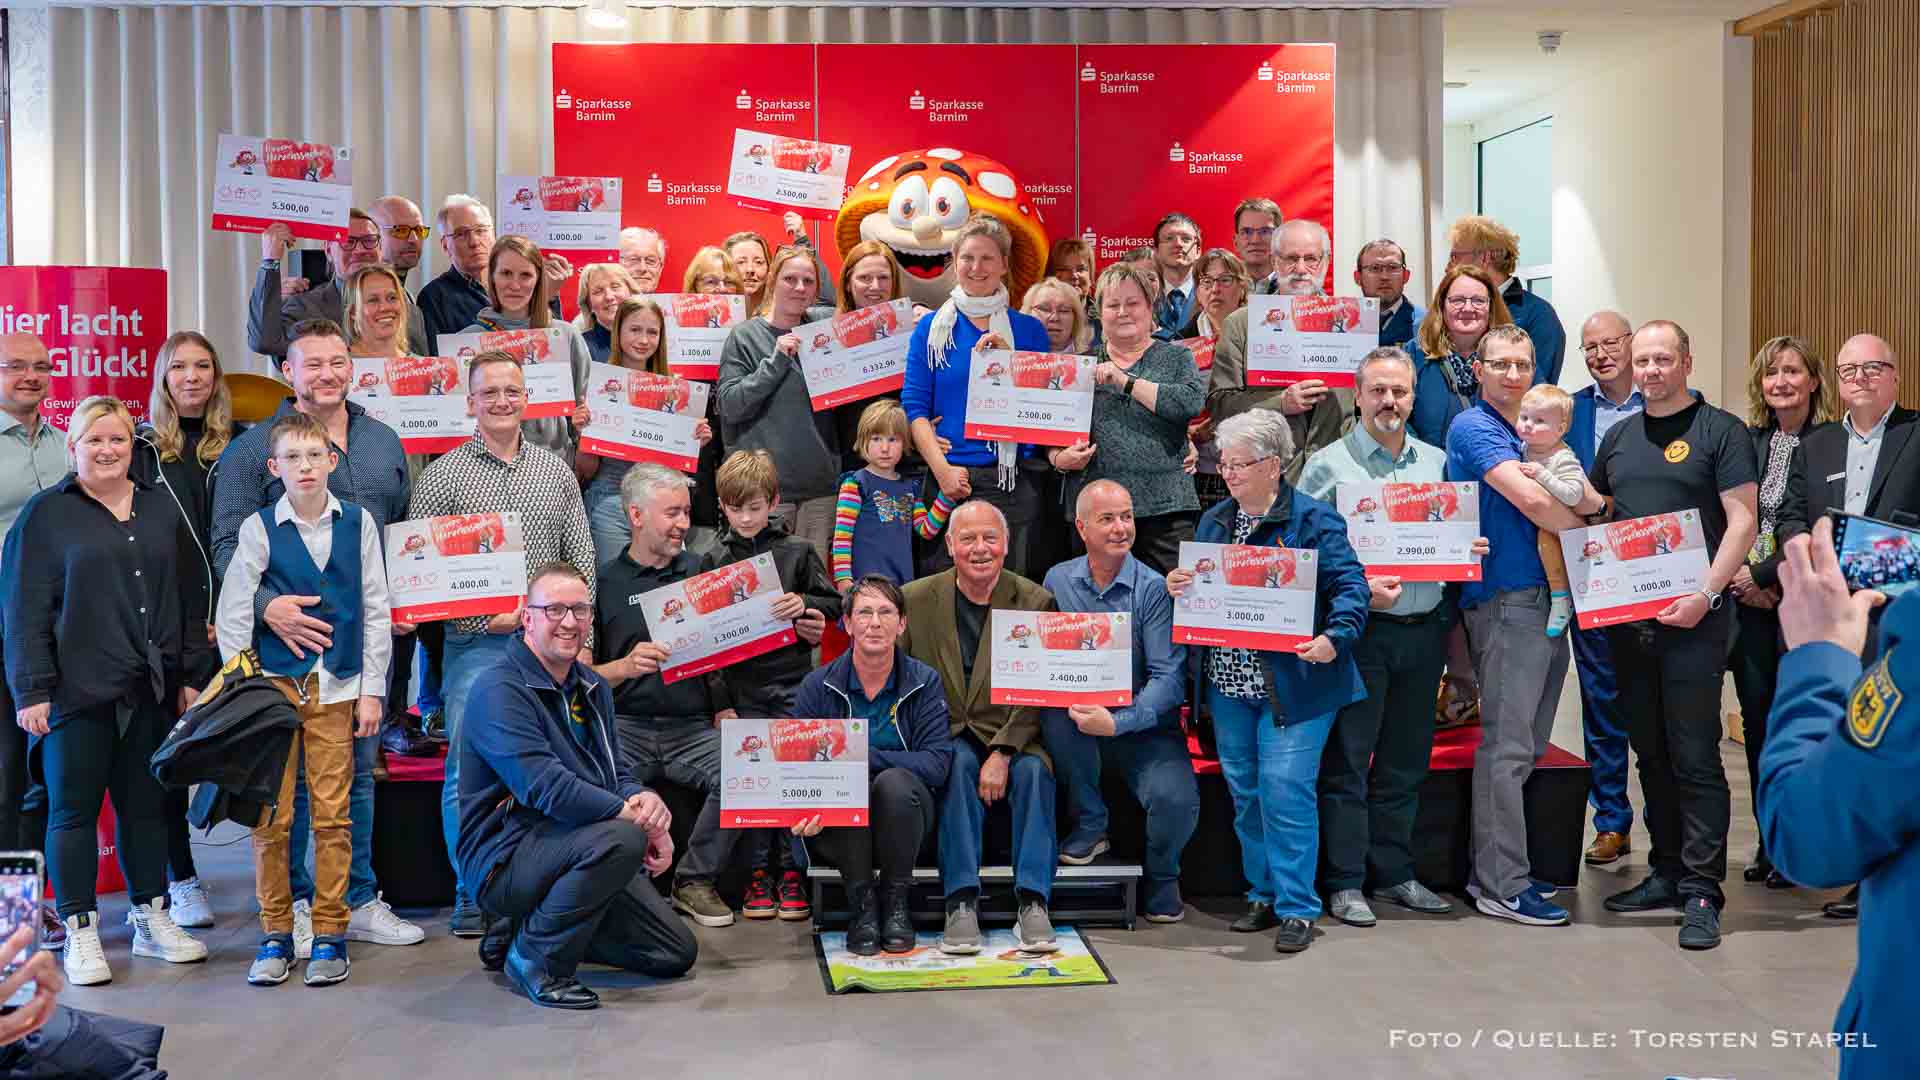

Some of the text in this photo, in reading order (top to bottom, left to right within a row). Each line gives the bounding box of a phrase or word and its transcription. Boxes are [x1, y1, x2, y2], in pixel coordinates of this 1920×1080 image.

[1099, 71, 1155, 83] Sparkasse
[1276, 70, 1331, 82] Sparkasse
[1100, 84, 1139, 93] Barnim
[1277, 83, 1316, 93] Barnim
[575, 98, 632, 111] Sparkasse
[755, 99, 811, 111] Sparkasse
[928, 99, 984, 111] Sparkasse
[576, 111, 616, 121] Barnim
[756, 112, 795, 121] Barnim
[929, 112, 968, 122] Barnim
[1188, 151, 1243, 163] Sparkasse
[1188, 164, 1228, 174] Barnim
[666, 182, 722, 195] Sparkasse
[775, 188, 808, 200] 2.500,00
[1024, 183, 1073, 194] parkasse
[667, 195, 707, 206] Barnim
[1032, 195, 1057, 206] rnim
[271, 201, 310, 214] 5.500,00
[548, 233, 583, 241] 1.000,00
[1100, 236, 1156, 248] Sparkasse
[58, 304, 144, 337] lacht
[47, 347, 148, 378] Glück!
[1302, 354, 1338, 364] 1.400,00
[862, 359, 896, 374] 6.332,96
[1017, 410, 1052, 421] 2.500,00
[400, 419, 439, 429] 4.000,00
[631, 429, 664, 442] 2.500,00
[1396, 546, 1436, 556] 2.990,00
[450, 579, 489, 590] 4.000,00
[1632, 579, 1672, 593] 1.000,00
[1225, 610, 1265, 622] 3.000,00
[713, 625, 750, 645] 1.300,00
[1048, 673, 1089, 683] 2.400,00
[781, 788, 823, 799] 5.000,00
